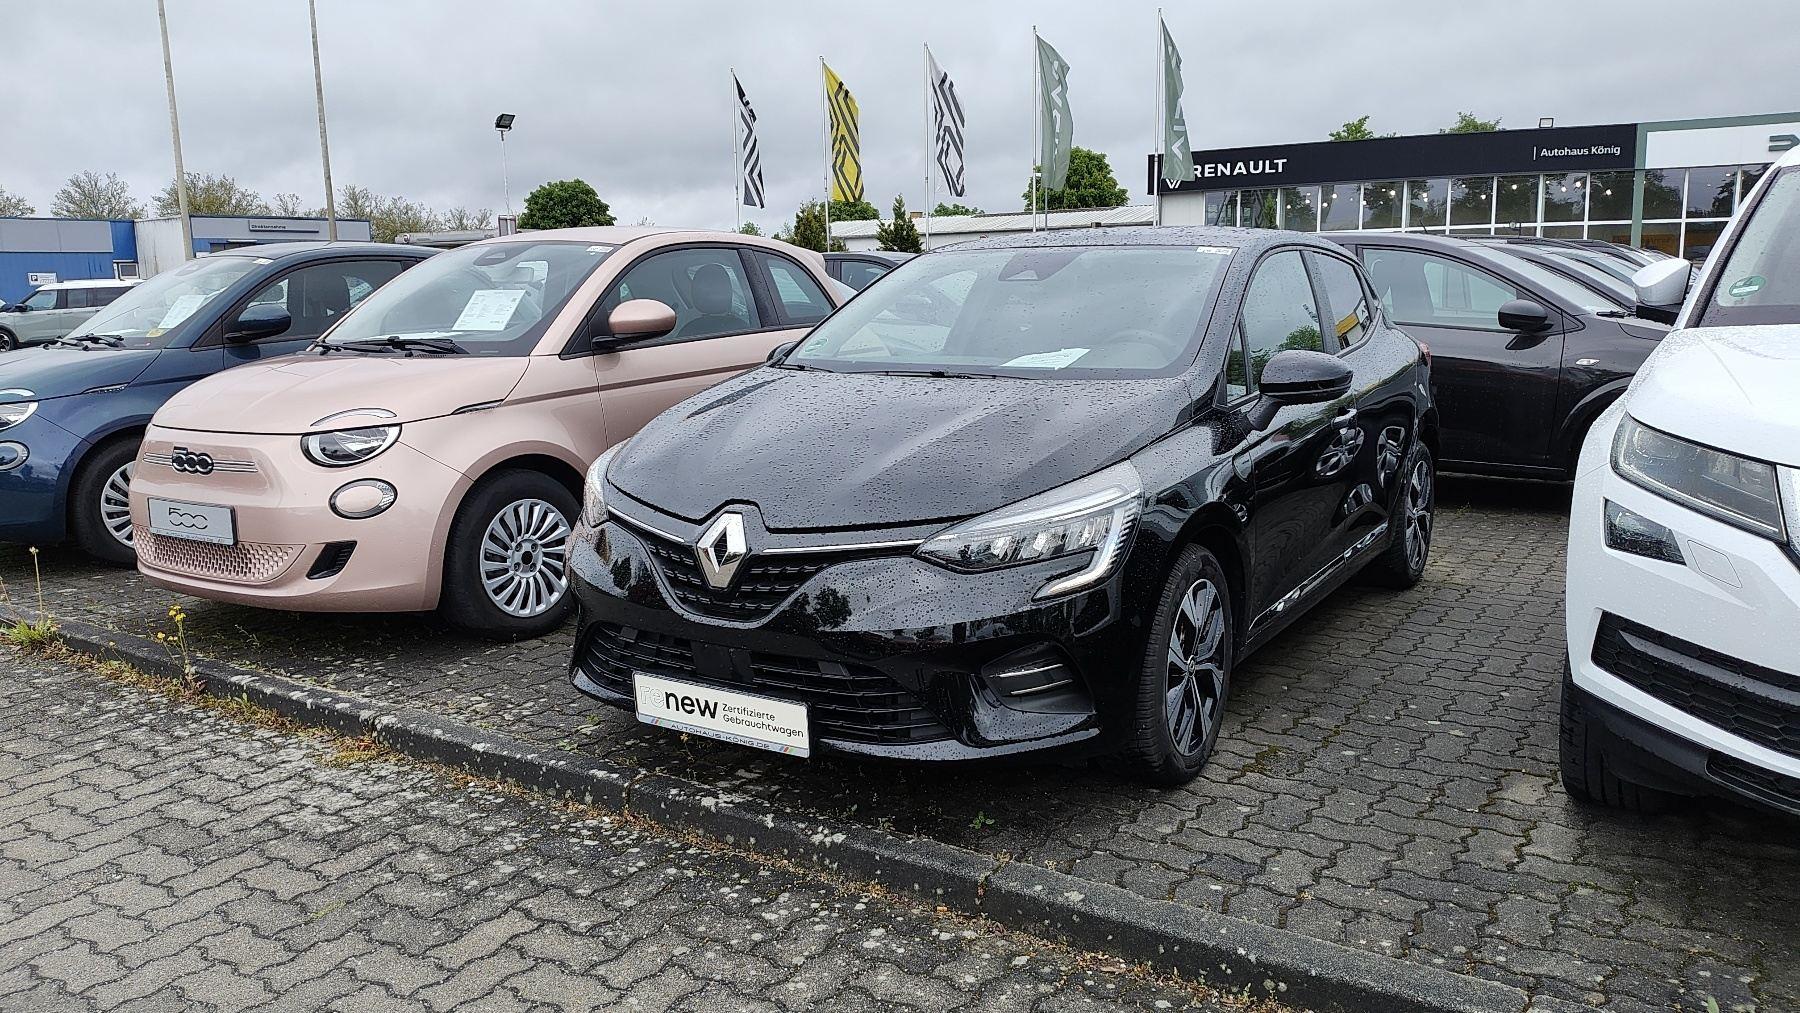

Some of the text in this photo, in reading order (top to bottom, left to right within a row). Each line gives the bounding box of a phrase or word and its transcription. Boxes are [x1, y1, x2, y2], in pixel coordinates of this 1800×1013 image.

[1540, 145, 1621, 157] Autohaus König
[1193, 158, 1287, 178] RENAULT
[172, 446, 215, 475] 500
[168, 507, 208, 530] 500
[639, 685, 719, 719] renew
[722, 703, 776, 721] Zertifizierte
[723, 714, 804, 738] Gebrauchtwagen
